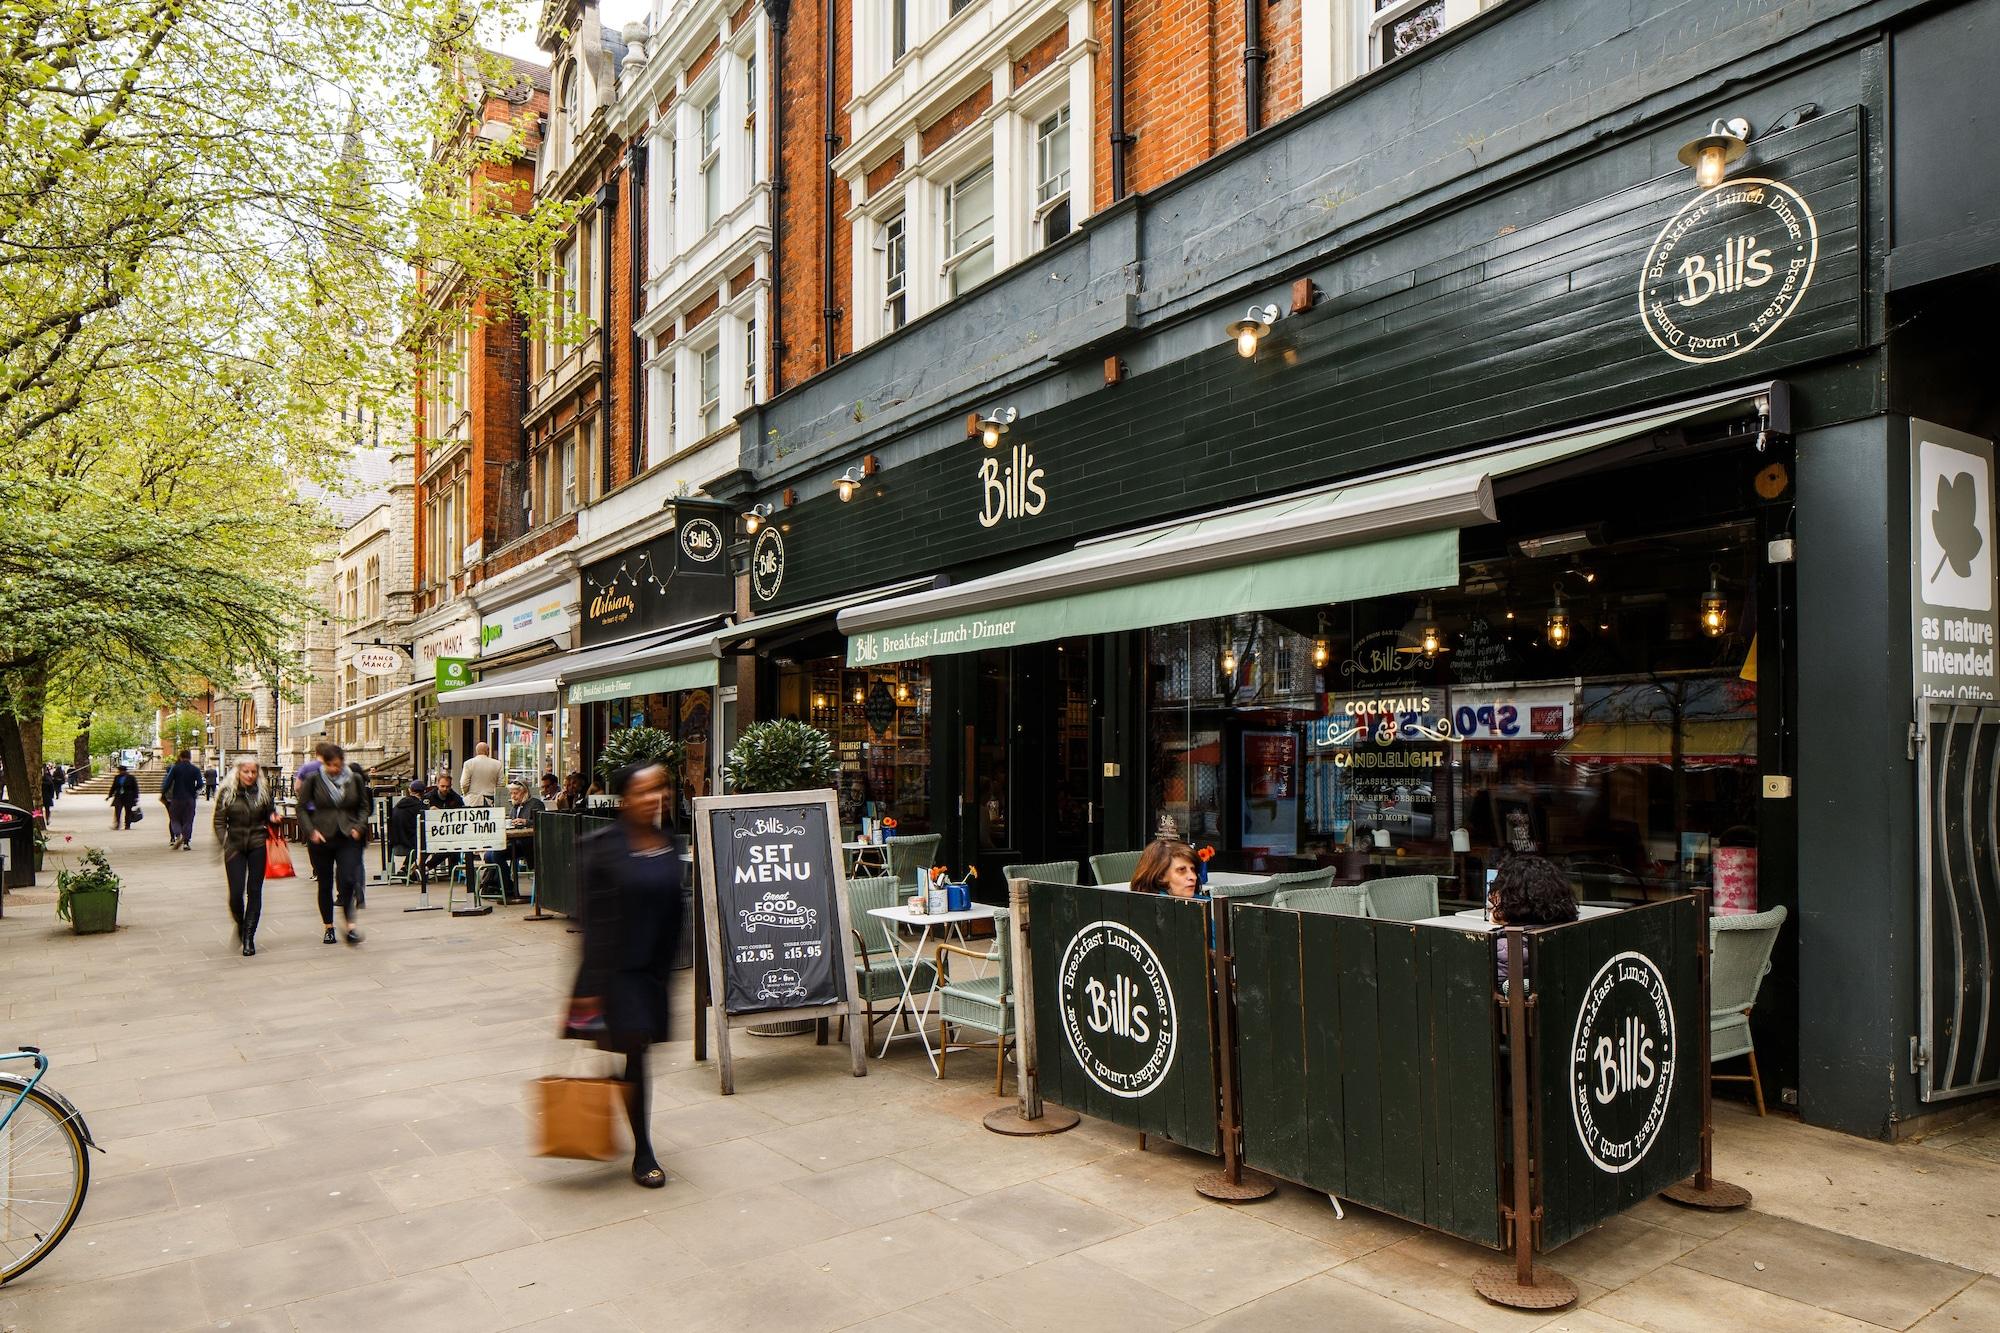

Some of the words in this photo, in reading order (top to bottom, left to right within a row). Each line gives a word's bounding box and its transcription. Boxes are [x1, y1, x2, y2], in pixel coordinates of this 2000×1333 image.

[1649, 205, 1709, 279] Breakfast
[1715, 189, 1765, 208] Lunch
[1767, 194, 1802, 240] Dinner
[1677, 235, 1773, 307] Bill's
[1749, 258, 1807, 333] Breakfast
[1651, 301, 1685, 346] Dinner
[1688, 333, 1740, 352] Lunch
[978, 443, 1046, 527] Bill's
[689, 530, 713, 548] Bill's
[759, 550, 777, 576] Bill's
[855, 634, 878, 662] Bill's
[883, 632, 929, 653] Breakfast
[933, 624, 967, 644] Lunch
[973, 620, 1016, 639] Dinner
[1922, 617, 1939, 640] as
[1944, 617, 1993, 645] nature
[1370, 646, 1402, 673] Bill's
[1922, 643, 1993, 677] intended
[1345, 697, 1431, 716] COCKTAILS
[1375, 721, 1398, 747] &
[1334, 752, 1443, 768] CANDLELIGHT
[1391, 778, 1421, 786] DISHES
[1394, 795, 1437, 803] DESSERTS
[754, 817, 784, 834] Bill's
[749, 844, 793, 863] SET
[735, 862, 811, 884] MENU
[754, 900, 797, 912] FOOD
[763, 891, 790, 900] Great
[749, 914, 776, 923] GOOD
[778, 917, 805, 925] TIMES
[736, 949, 774, 963] £12.95
[785, 946, 822, 959] £15.95
[768, 975, 777, 983] 12
[1064, 932, 1104, 989] Breakfast
[1107, 930, 1142, 962] Lunch
[1143, 959, 1167, 1016] Dinner
[1085, 974, 1150, 1043] Bill's
[1576, 974, 1615, 1062] Breakfast
[1619, 963, 1649, 988] Lunch
[1650, 981, 1669, 1036] Dinner
[1067, 1006, 1092, 1061] Dinner
[1128, 1029, 1171, 1087] Breakfast
[1594, 1016, 1654, 1104] Bill's
[1095, 1059, 1129, 1090] Lunch
[1578, 1085, 1599, 1147] Dinner
[1635, 1060, 1670, 1149] Breakfast
[1600, 1137, 1632, 1160] Lunch
